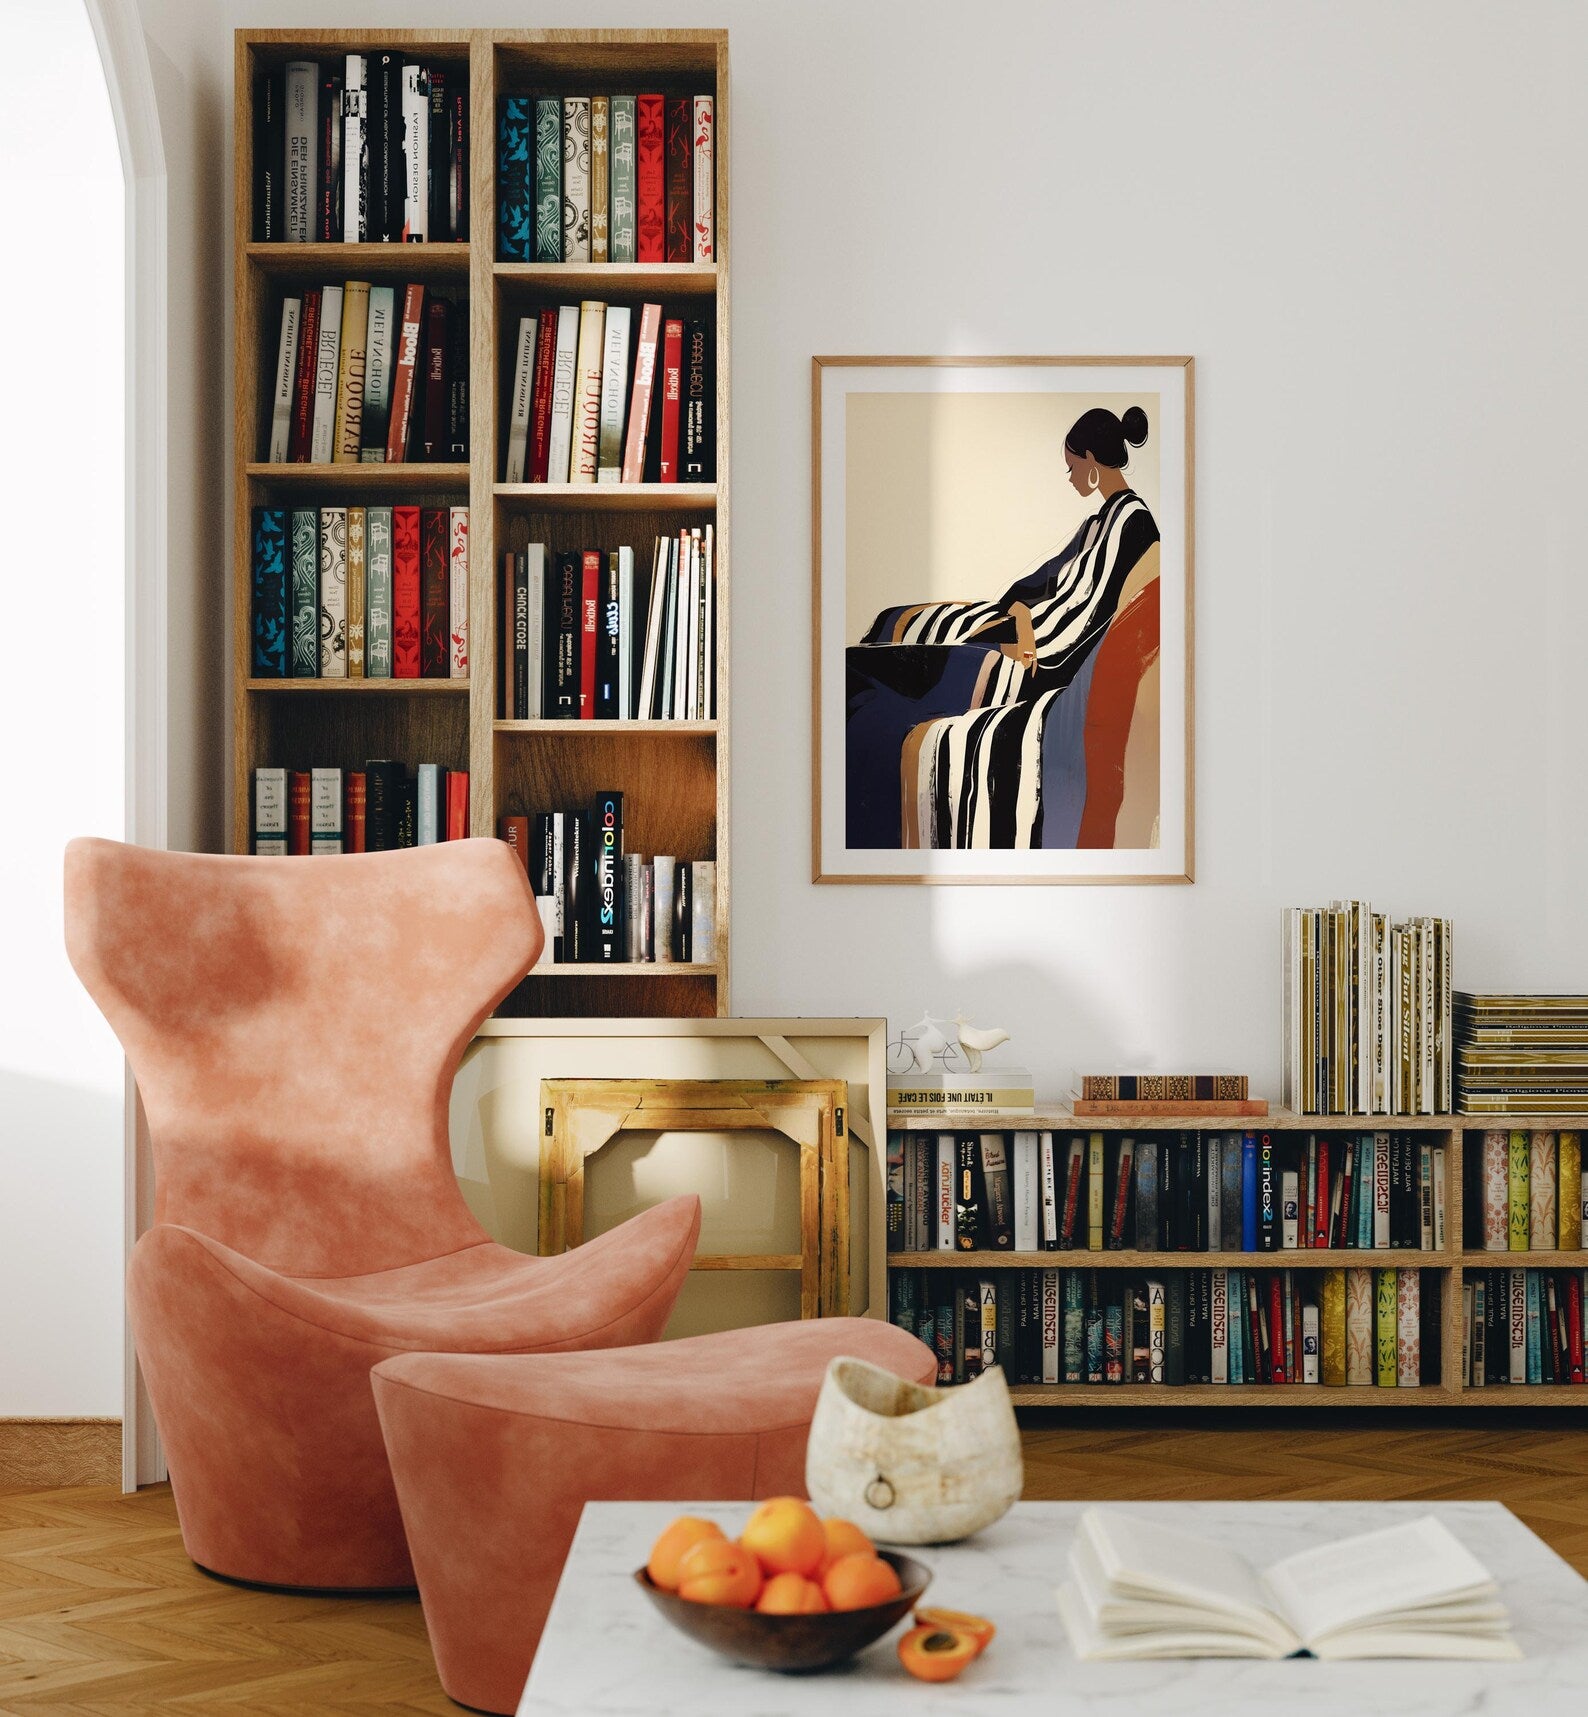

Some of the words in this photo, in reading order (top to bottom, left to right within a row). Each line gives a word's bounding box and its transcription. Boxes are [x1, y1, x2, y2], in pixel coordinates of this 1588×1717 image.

[1402, 1008, 1410, 1062] Silent
[898, 1092, 917, 1104] CAFÉ
[919, 1093, 928, 1103] LE
[929, 1092, 945, 1103] FOIS
[947, 1092, 962, 1102] UNE
[964, 1092, 984, 1104] ÉTAIT
[986, 1092, 992, 1102] IL
[966, 1141, 974, 1167] Shriek
[993, 1177, 1003, 1202] Margaret
[996, 1204, 1005, 1226] Atwood
